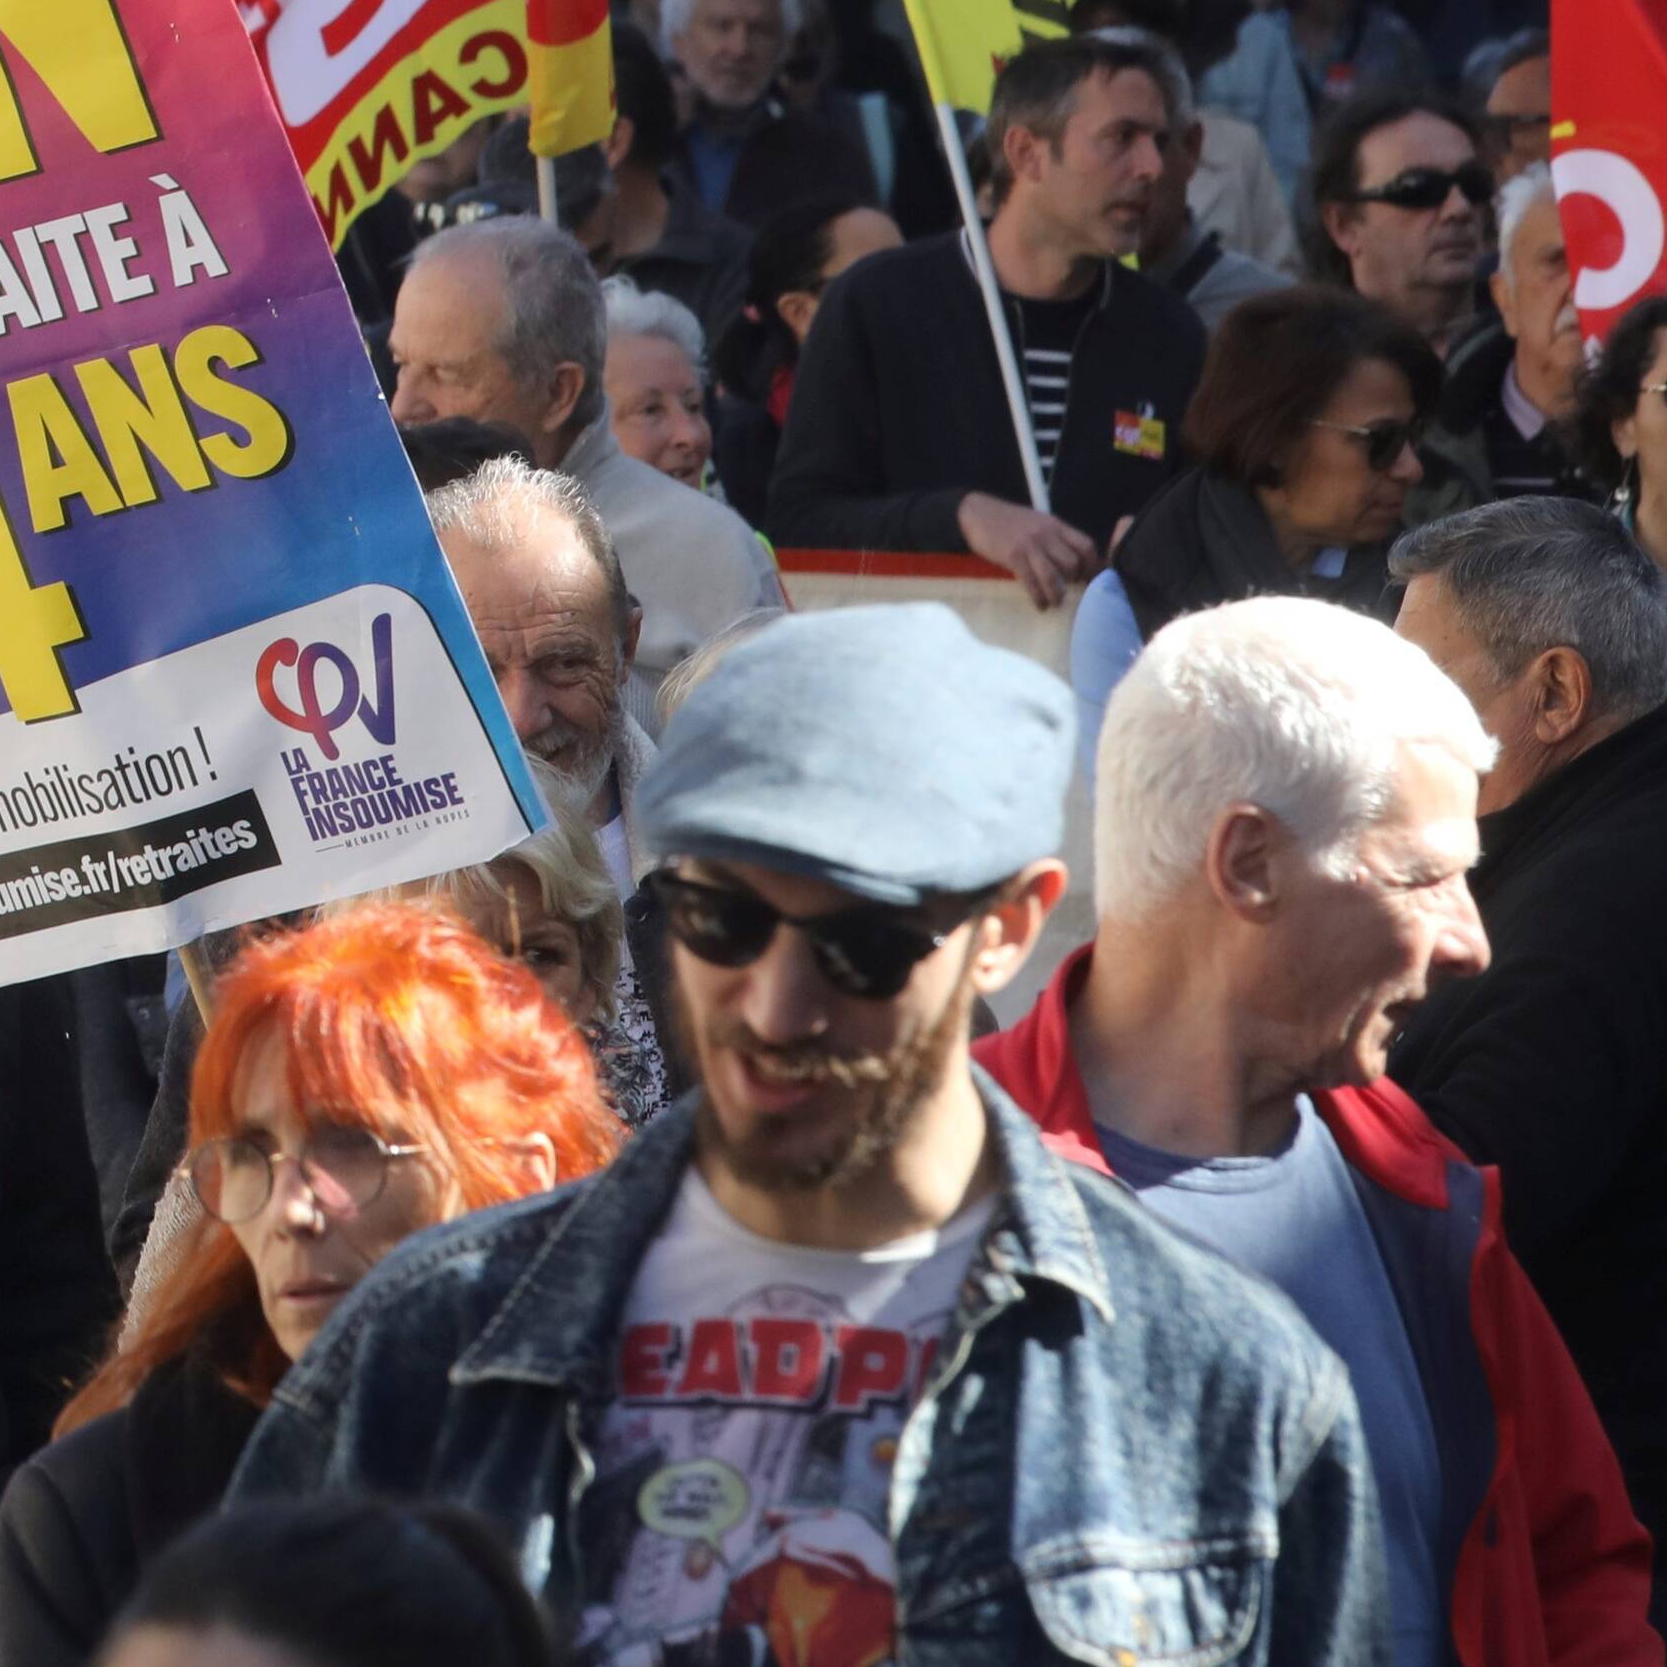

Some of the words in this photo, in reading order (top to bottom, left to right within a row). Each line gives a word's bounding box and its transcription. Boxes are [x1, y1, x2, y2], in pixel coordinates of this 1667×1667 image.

[148, 172, 231, 291] À
[6, 324, 296, 533] ANS
[280, 746, 313, 777] LA
[289, 753, 405, 817] FRANCE
[302, 771, 466, 842] INSOUMISE
[343, 829, 391, 850] MEMBRE
[621, 1319, 941, 1410] EADP
